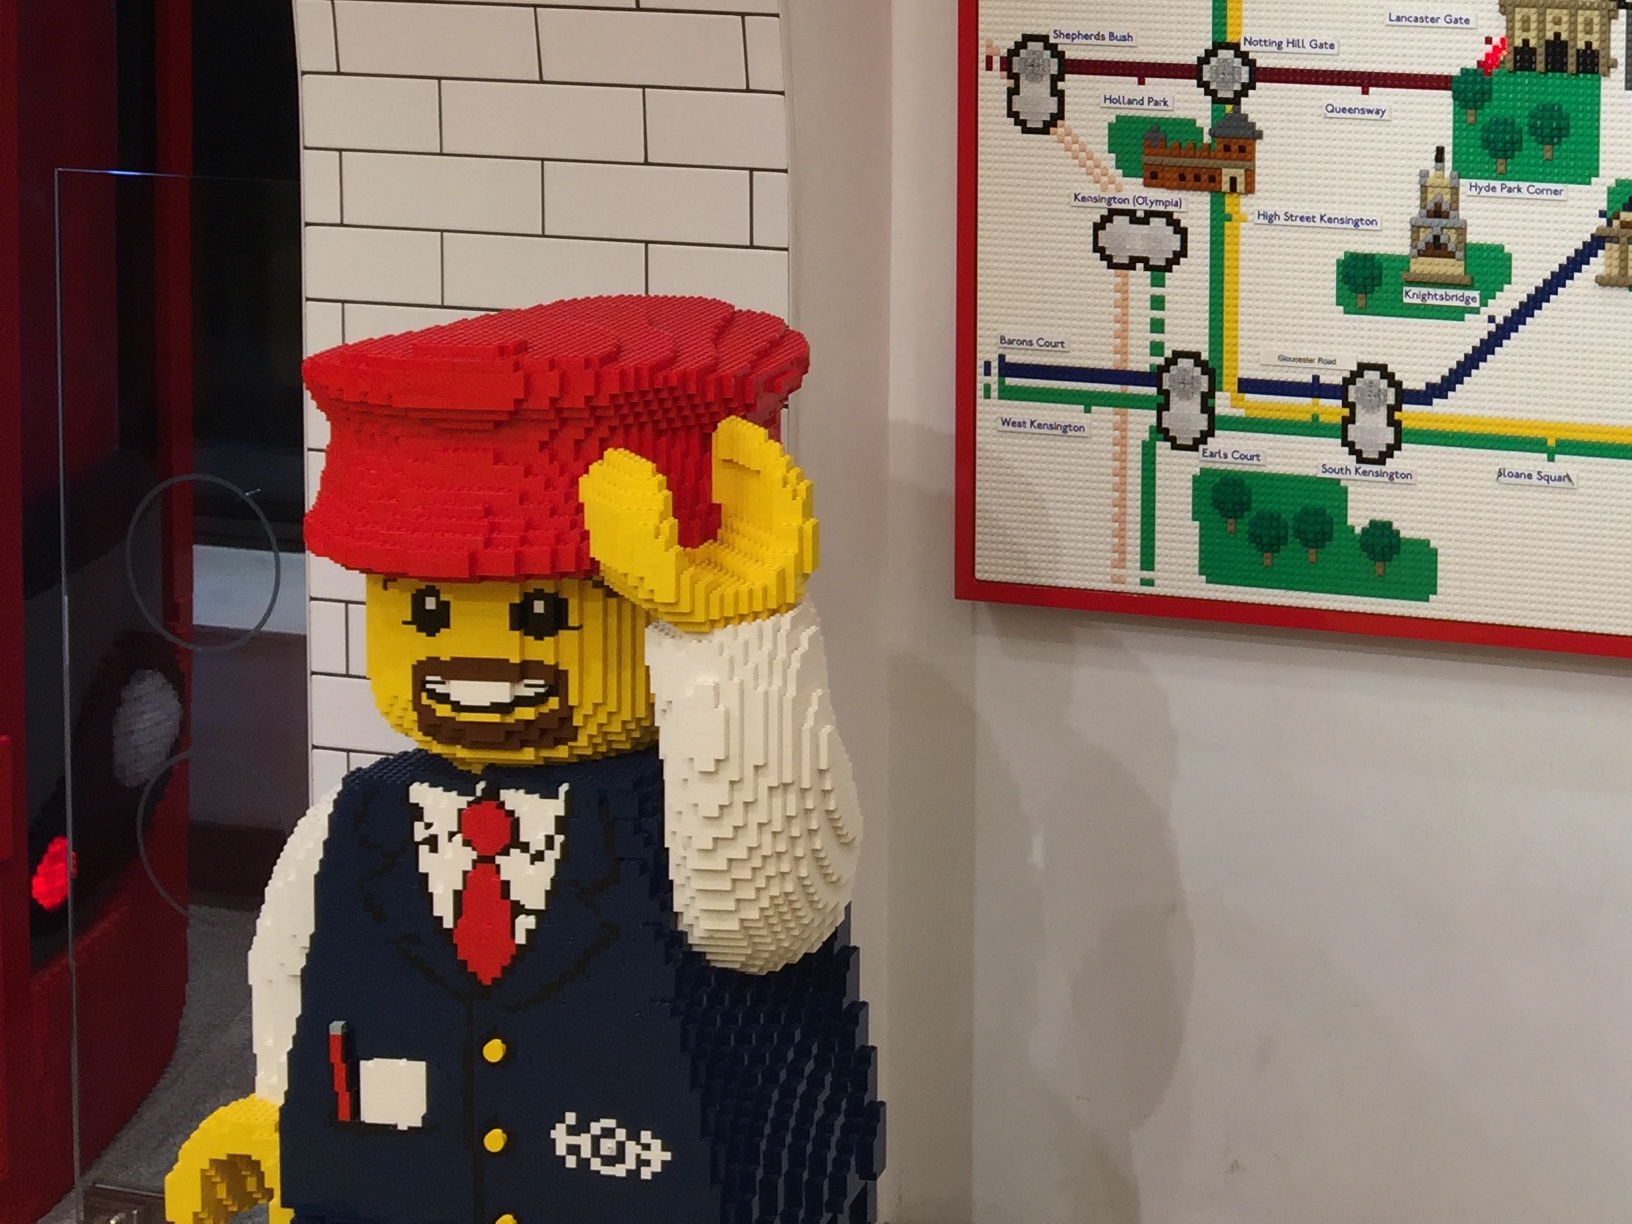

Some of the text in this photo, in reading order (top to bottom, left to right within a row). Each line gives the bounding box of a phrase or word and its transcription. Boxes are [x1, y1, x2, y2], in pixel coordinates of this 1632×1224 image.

[1389, 13, 1471, 26] Lancaster Gate
[1053, 30, 1133, 45] Shepherds Bush
[1244, 37, 1335, 51] Notting Hill Gate
[1103, 95, 1169, 107] Holland Park
[1325, 104, 1387, 118] Queensway
[1469, 182, 1564, 196] Hyde Park Corner
[1074, 193, 1182, 210] Kensington (Olympia)
[1257, 210, 1378, 228] High Street Kensington
[1404, 289, 1478, 305] Knightsbridge
[1000, 336, 1065, 349] Barons Court
[1318, 356, 1336, 366] Road
[1001, 417, 1085, 433] West Kensington
[1202, 448, 1261, 461] Earls Court
[1321, 464, 1413, 481] South Kensington
